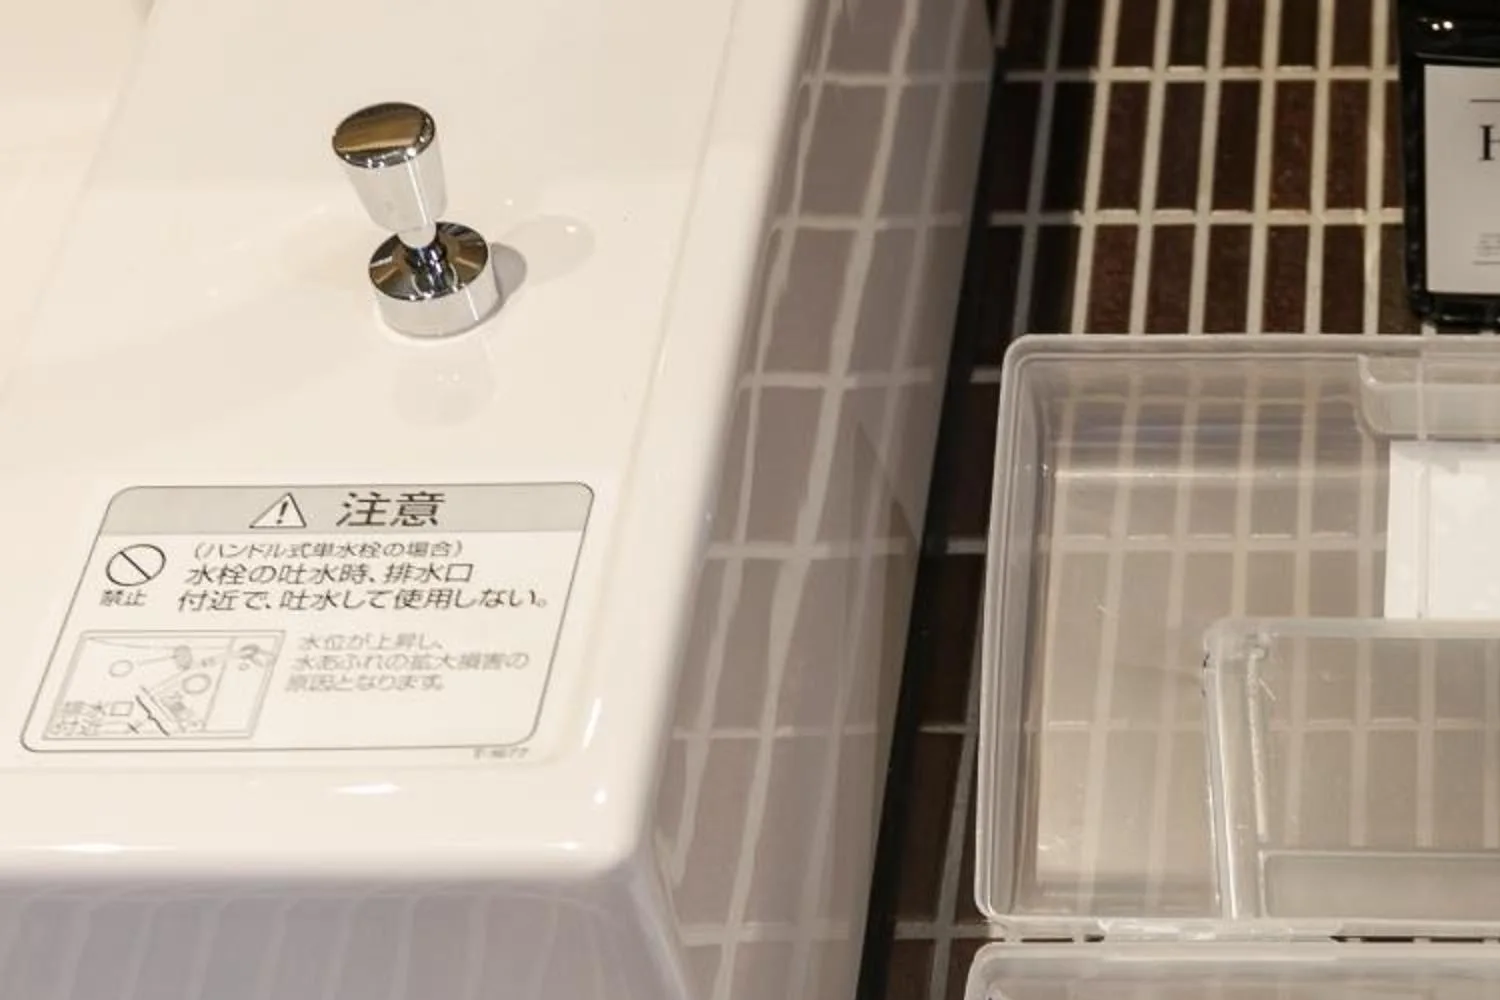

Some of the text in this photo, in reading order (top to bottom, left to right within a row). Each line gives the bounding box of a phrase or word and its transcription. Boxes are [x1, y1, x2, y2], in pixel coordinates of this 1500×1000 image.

[336, 491, 447, 527] 注意
[185, 562, 474, 586] 水栓の吐水時、排水口
[177, 588, 548, 613] 付近で、吐水して使用しない。
